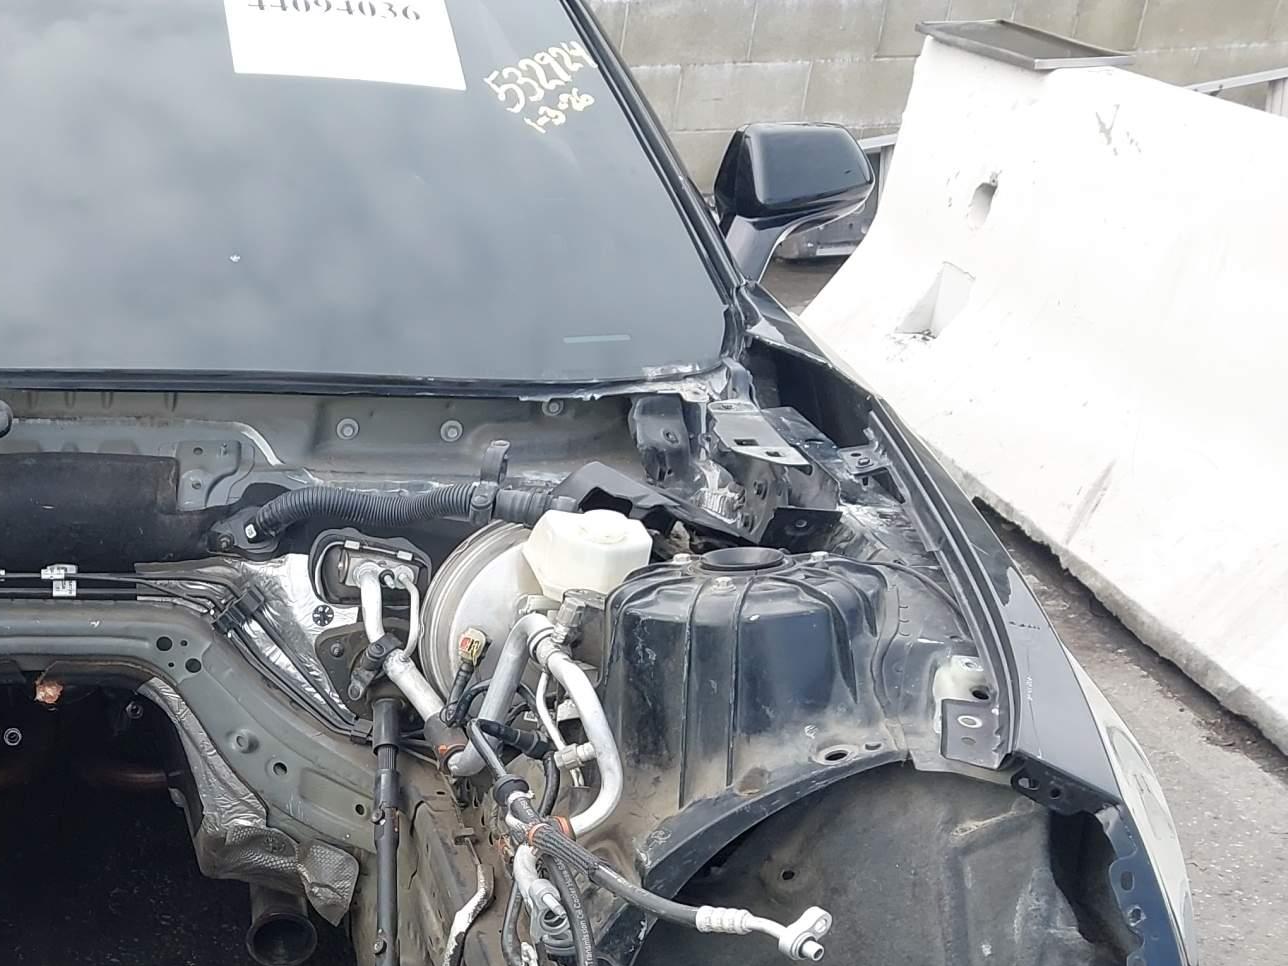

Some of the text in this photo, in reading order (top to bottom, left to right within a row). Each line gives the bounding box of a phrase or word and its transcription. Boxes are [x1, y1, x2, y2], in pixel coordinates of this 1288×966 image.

[483, 41, 598, 113] 532924
[571, 890, 581, 909] Cooler
[580, 920, 593, 966] Transmission
